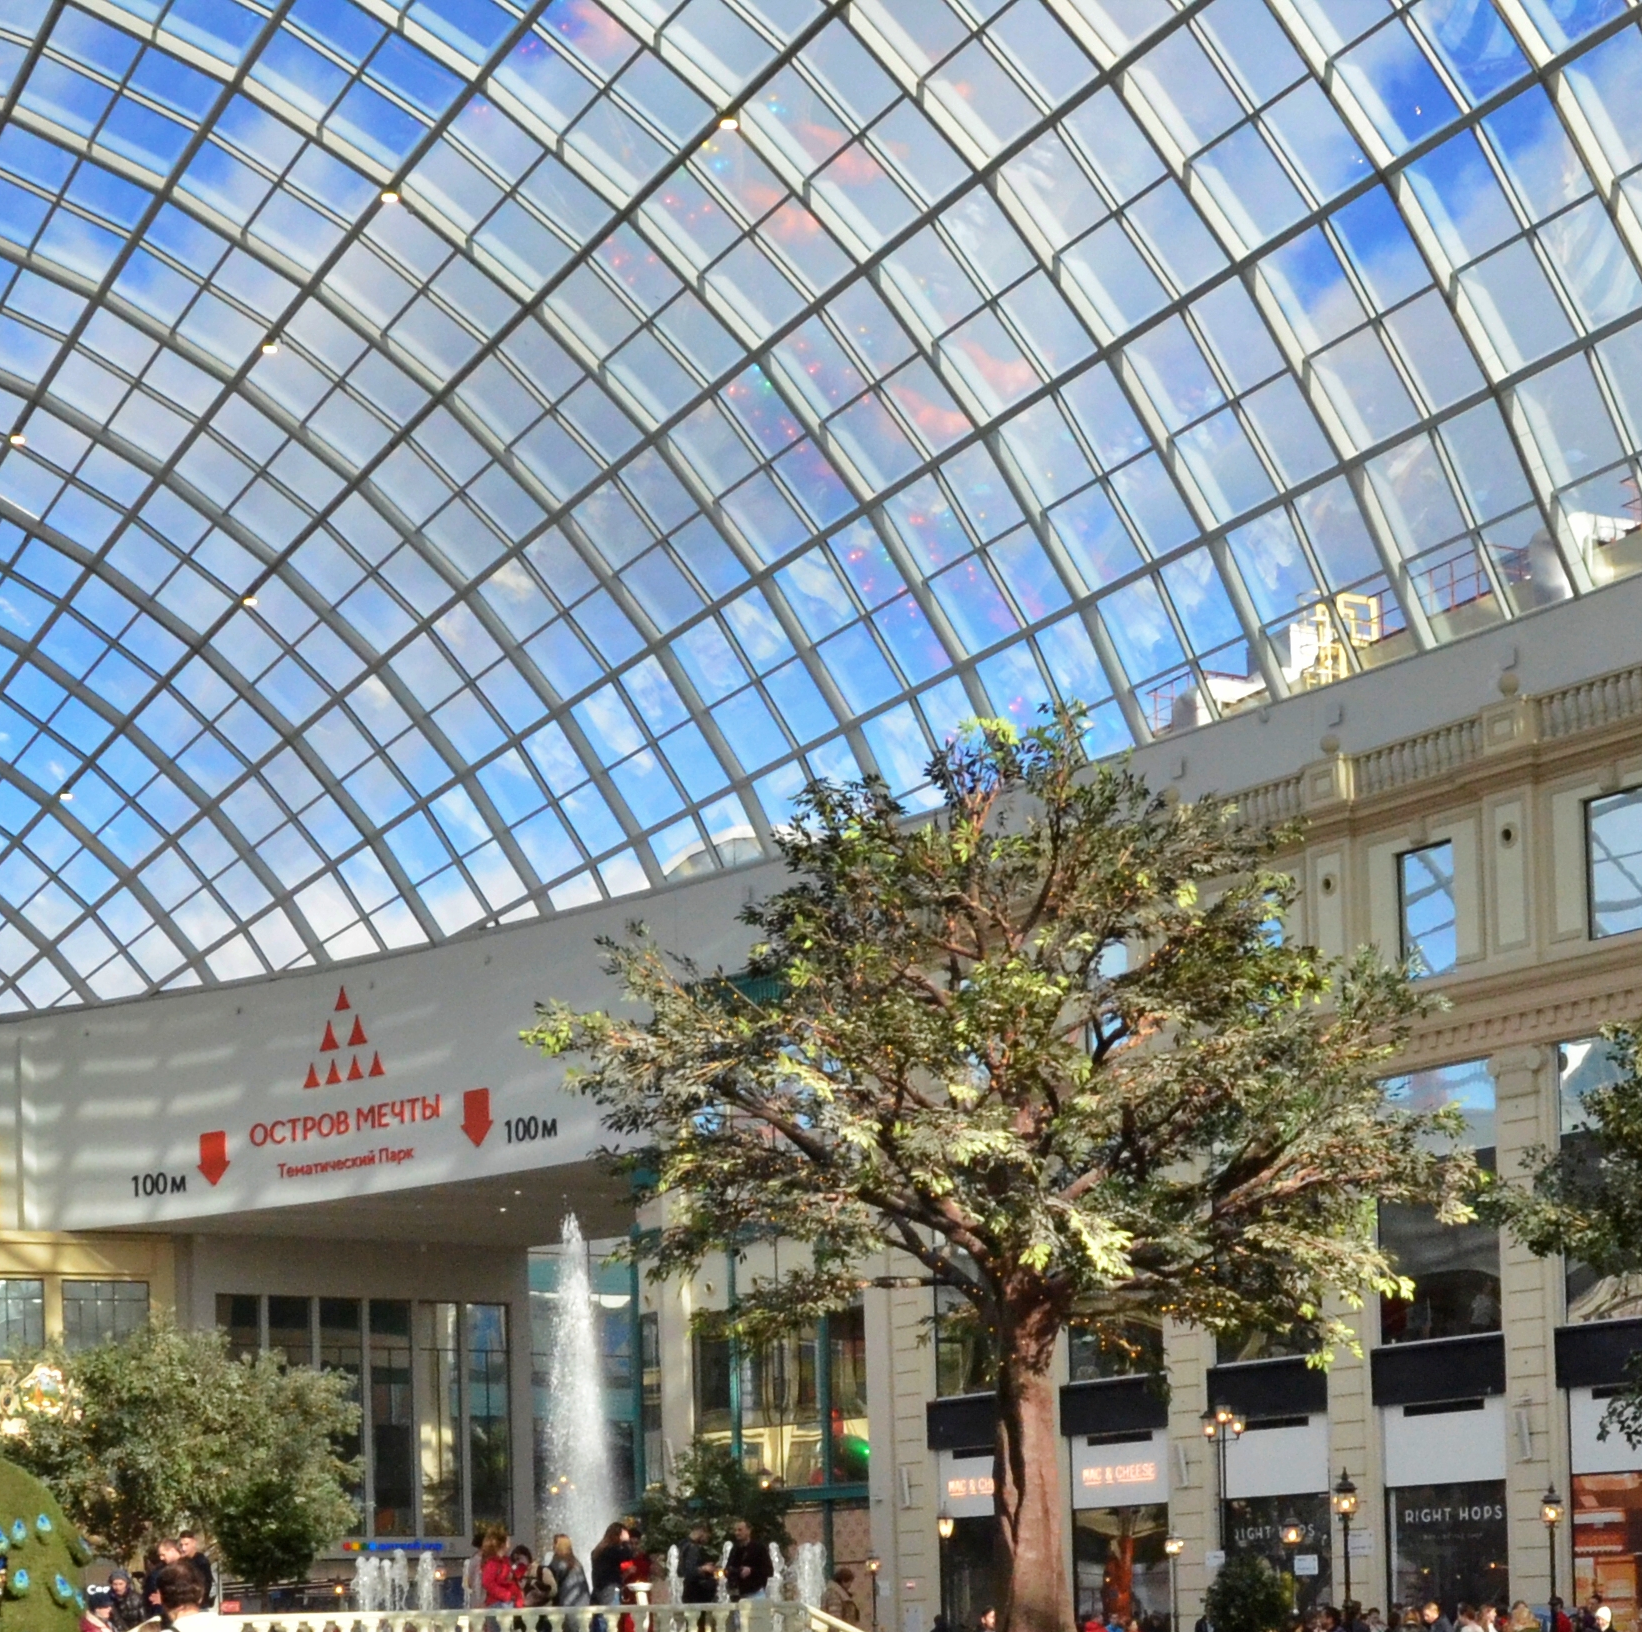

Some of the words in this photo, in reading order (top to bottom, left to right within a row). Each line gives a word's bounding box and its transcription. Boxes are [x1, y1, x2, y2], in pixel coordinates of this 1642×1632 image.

[249, 1110, 350, 1147] ОСТРОВ
[356, 1094, 443, 1132] МЕЧТЫ
[277, 1151, 376, 1179] Тематический
[378, 1147, 414, 1166] Парк
[1083, 1467, 1103, 1484] MAC
[1105, 1466, 1114, 1483] &
[1115, 1462, 1156, 1482] CHEESE
[948, 1479, 966, 1495] MAC
[1405, 1507, 1452, 1524] RIGHT
[1459, 1504, 1503, 1521] HOPS
